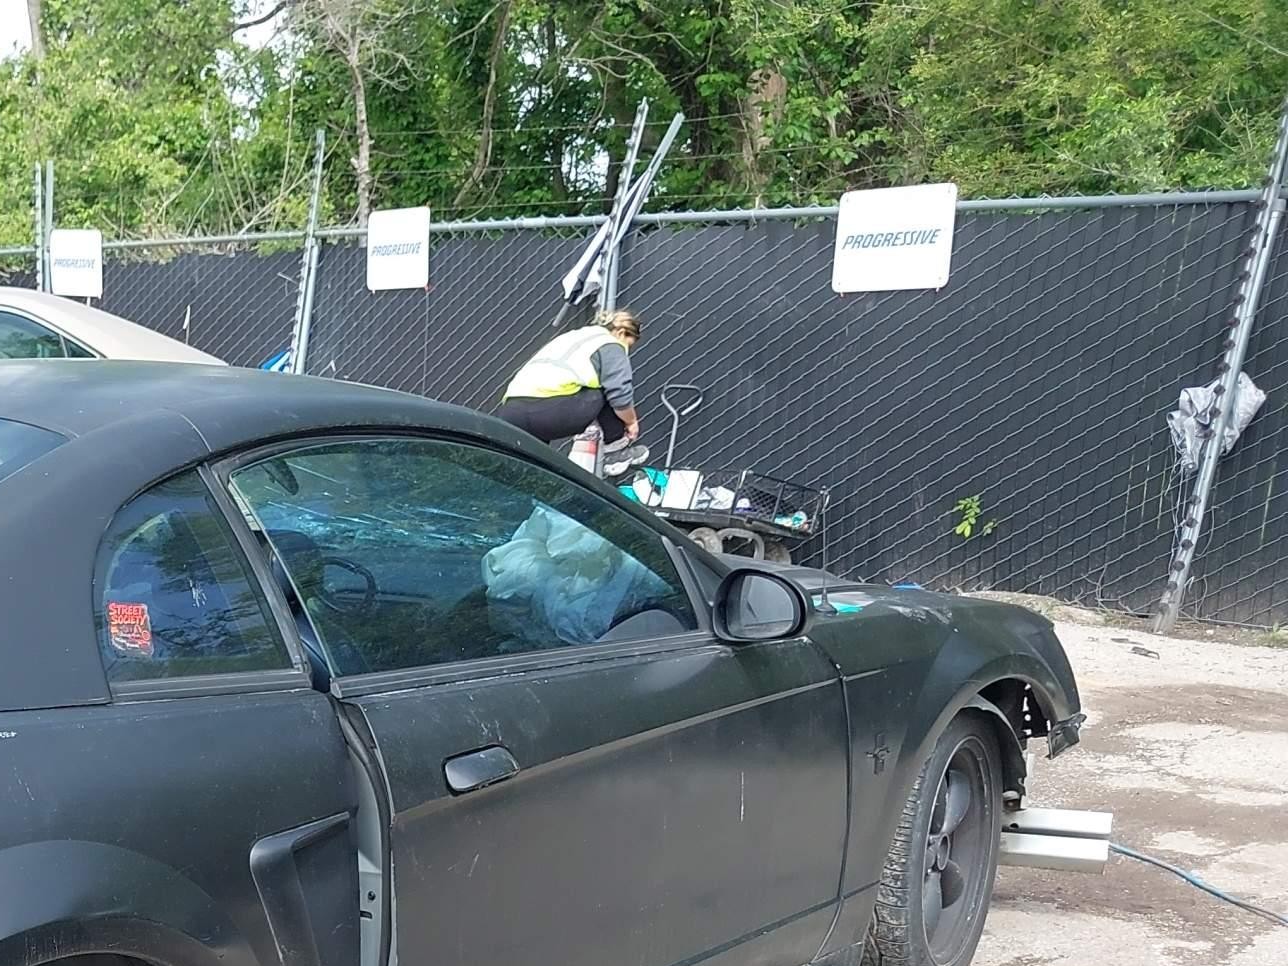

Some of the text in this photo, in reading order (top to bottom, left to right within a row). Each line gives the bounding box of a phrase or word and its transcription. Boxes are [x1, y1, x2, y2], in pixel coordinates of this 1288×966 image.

[841, 228, 942, 250] PROGRESSIVE
[108, 604, 143, 615] STREET
[110, 614, 146, 625] SOCIETY
